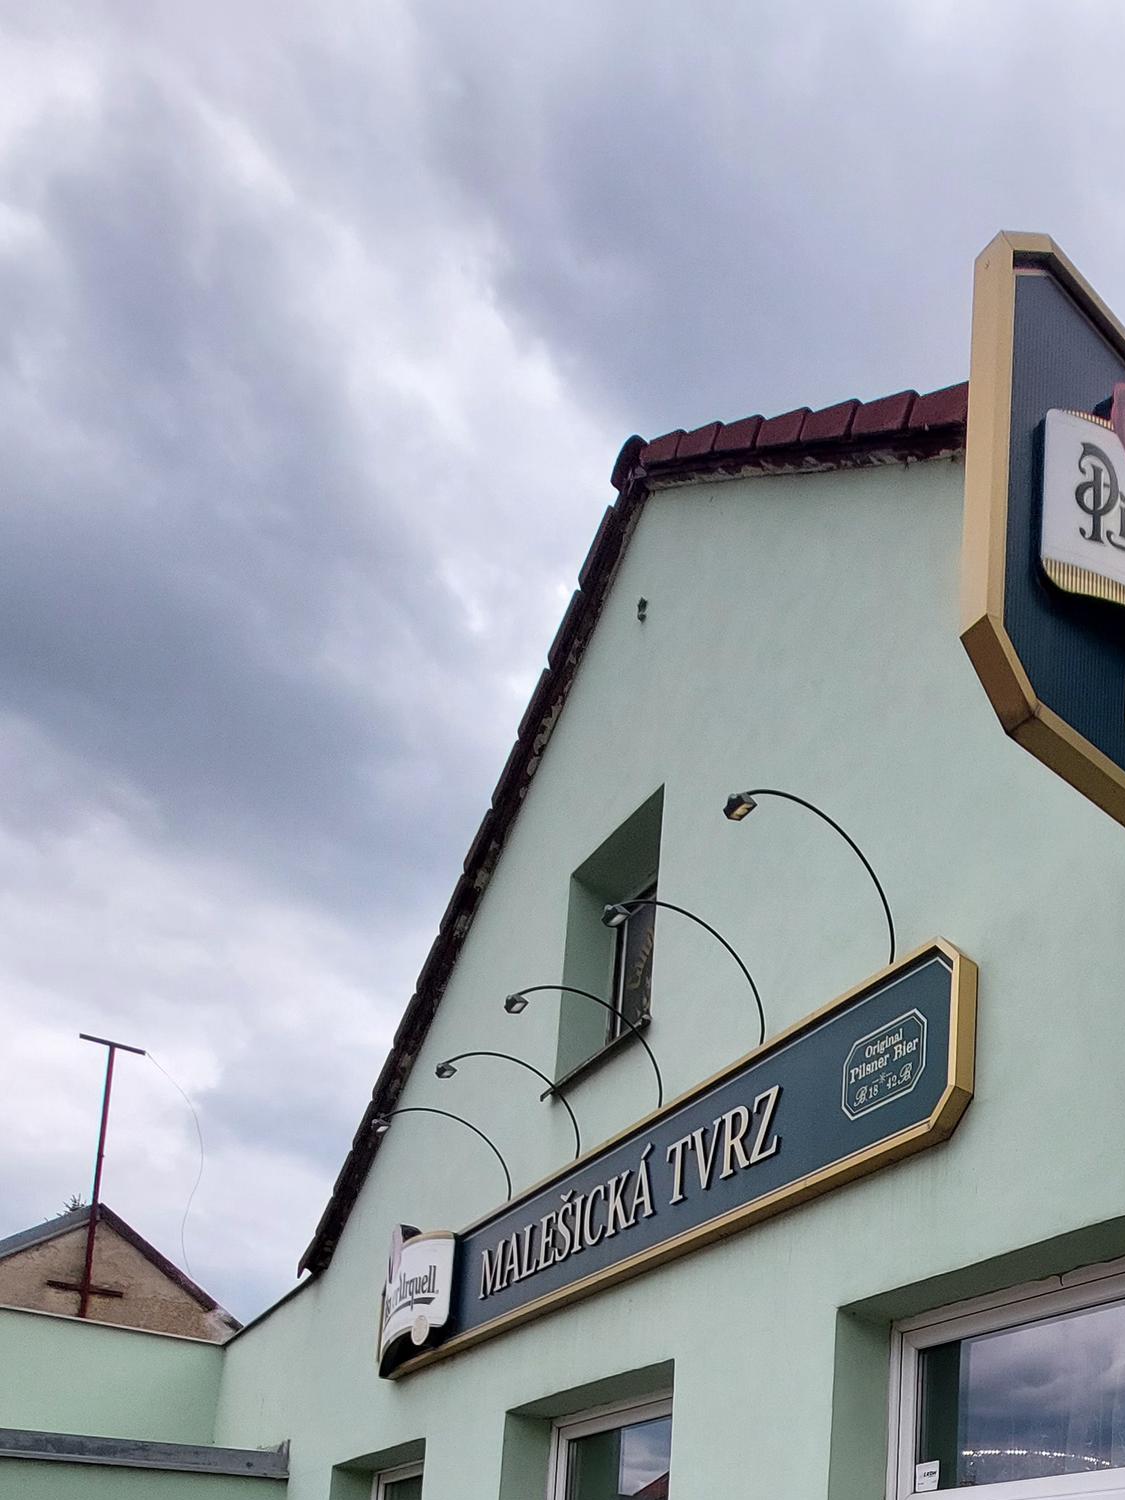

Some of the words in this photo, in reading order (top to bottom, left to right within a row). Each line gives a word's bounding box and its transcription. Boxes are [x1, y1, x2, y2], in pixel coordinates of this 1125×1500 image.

[849, 1053, 890, 1084] Pilsner
[893, 1037, 919, 1062] Bier
[865, 1027, 903, 1059] Original
[478, 1142, 654, 1300] MALEŠICKÁ
[666, 1084, 780, 1205] TVRZ
